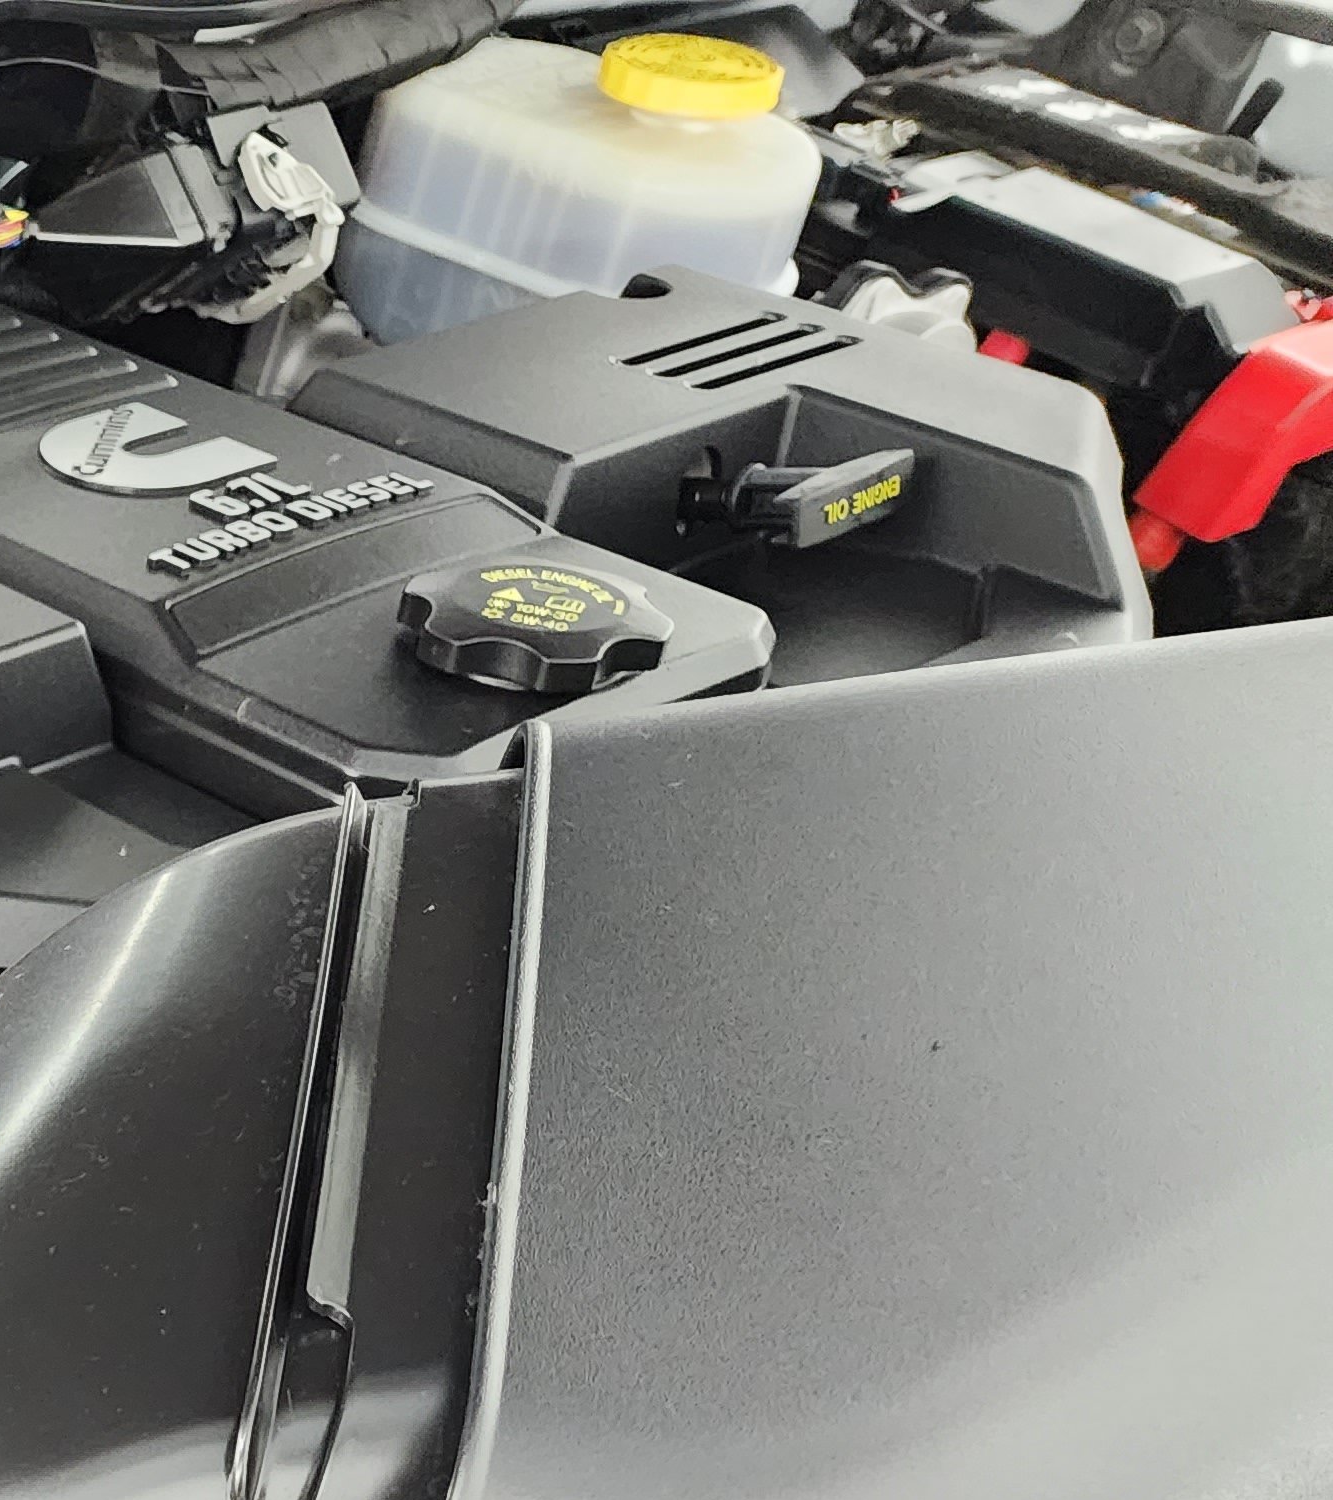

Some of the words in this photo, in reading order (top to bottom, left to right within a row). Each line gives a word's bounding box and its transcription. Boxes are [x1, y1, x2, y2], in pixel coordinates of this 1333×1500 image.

[73, 408, 133, 475] Cummins
[188, 471, 312, 519] 6.7L
[823, 497, 850, 525] OIL
[851, 474, 901, 515] ENGINE
[146, 510, 299, 571] TURBO
[285, 471, 435, 523] DIESEL
